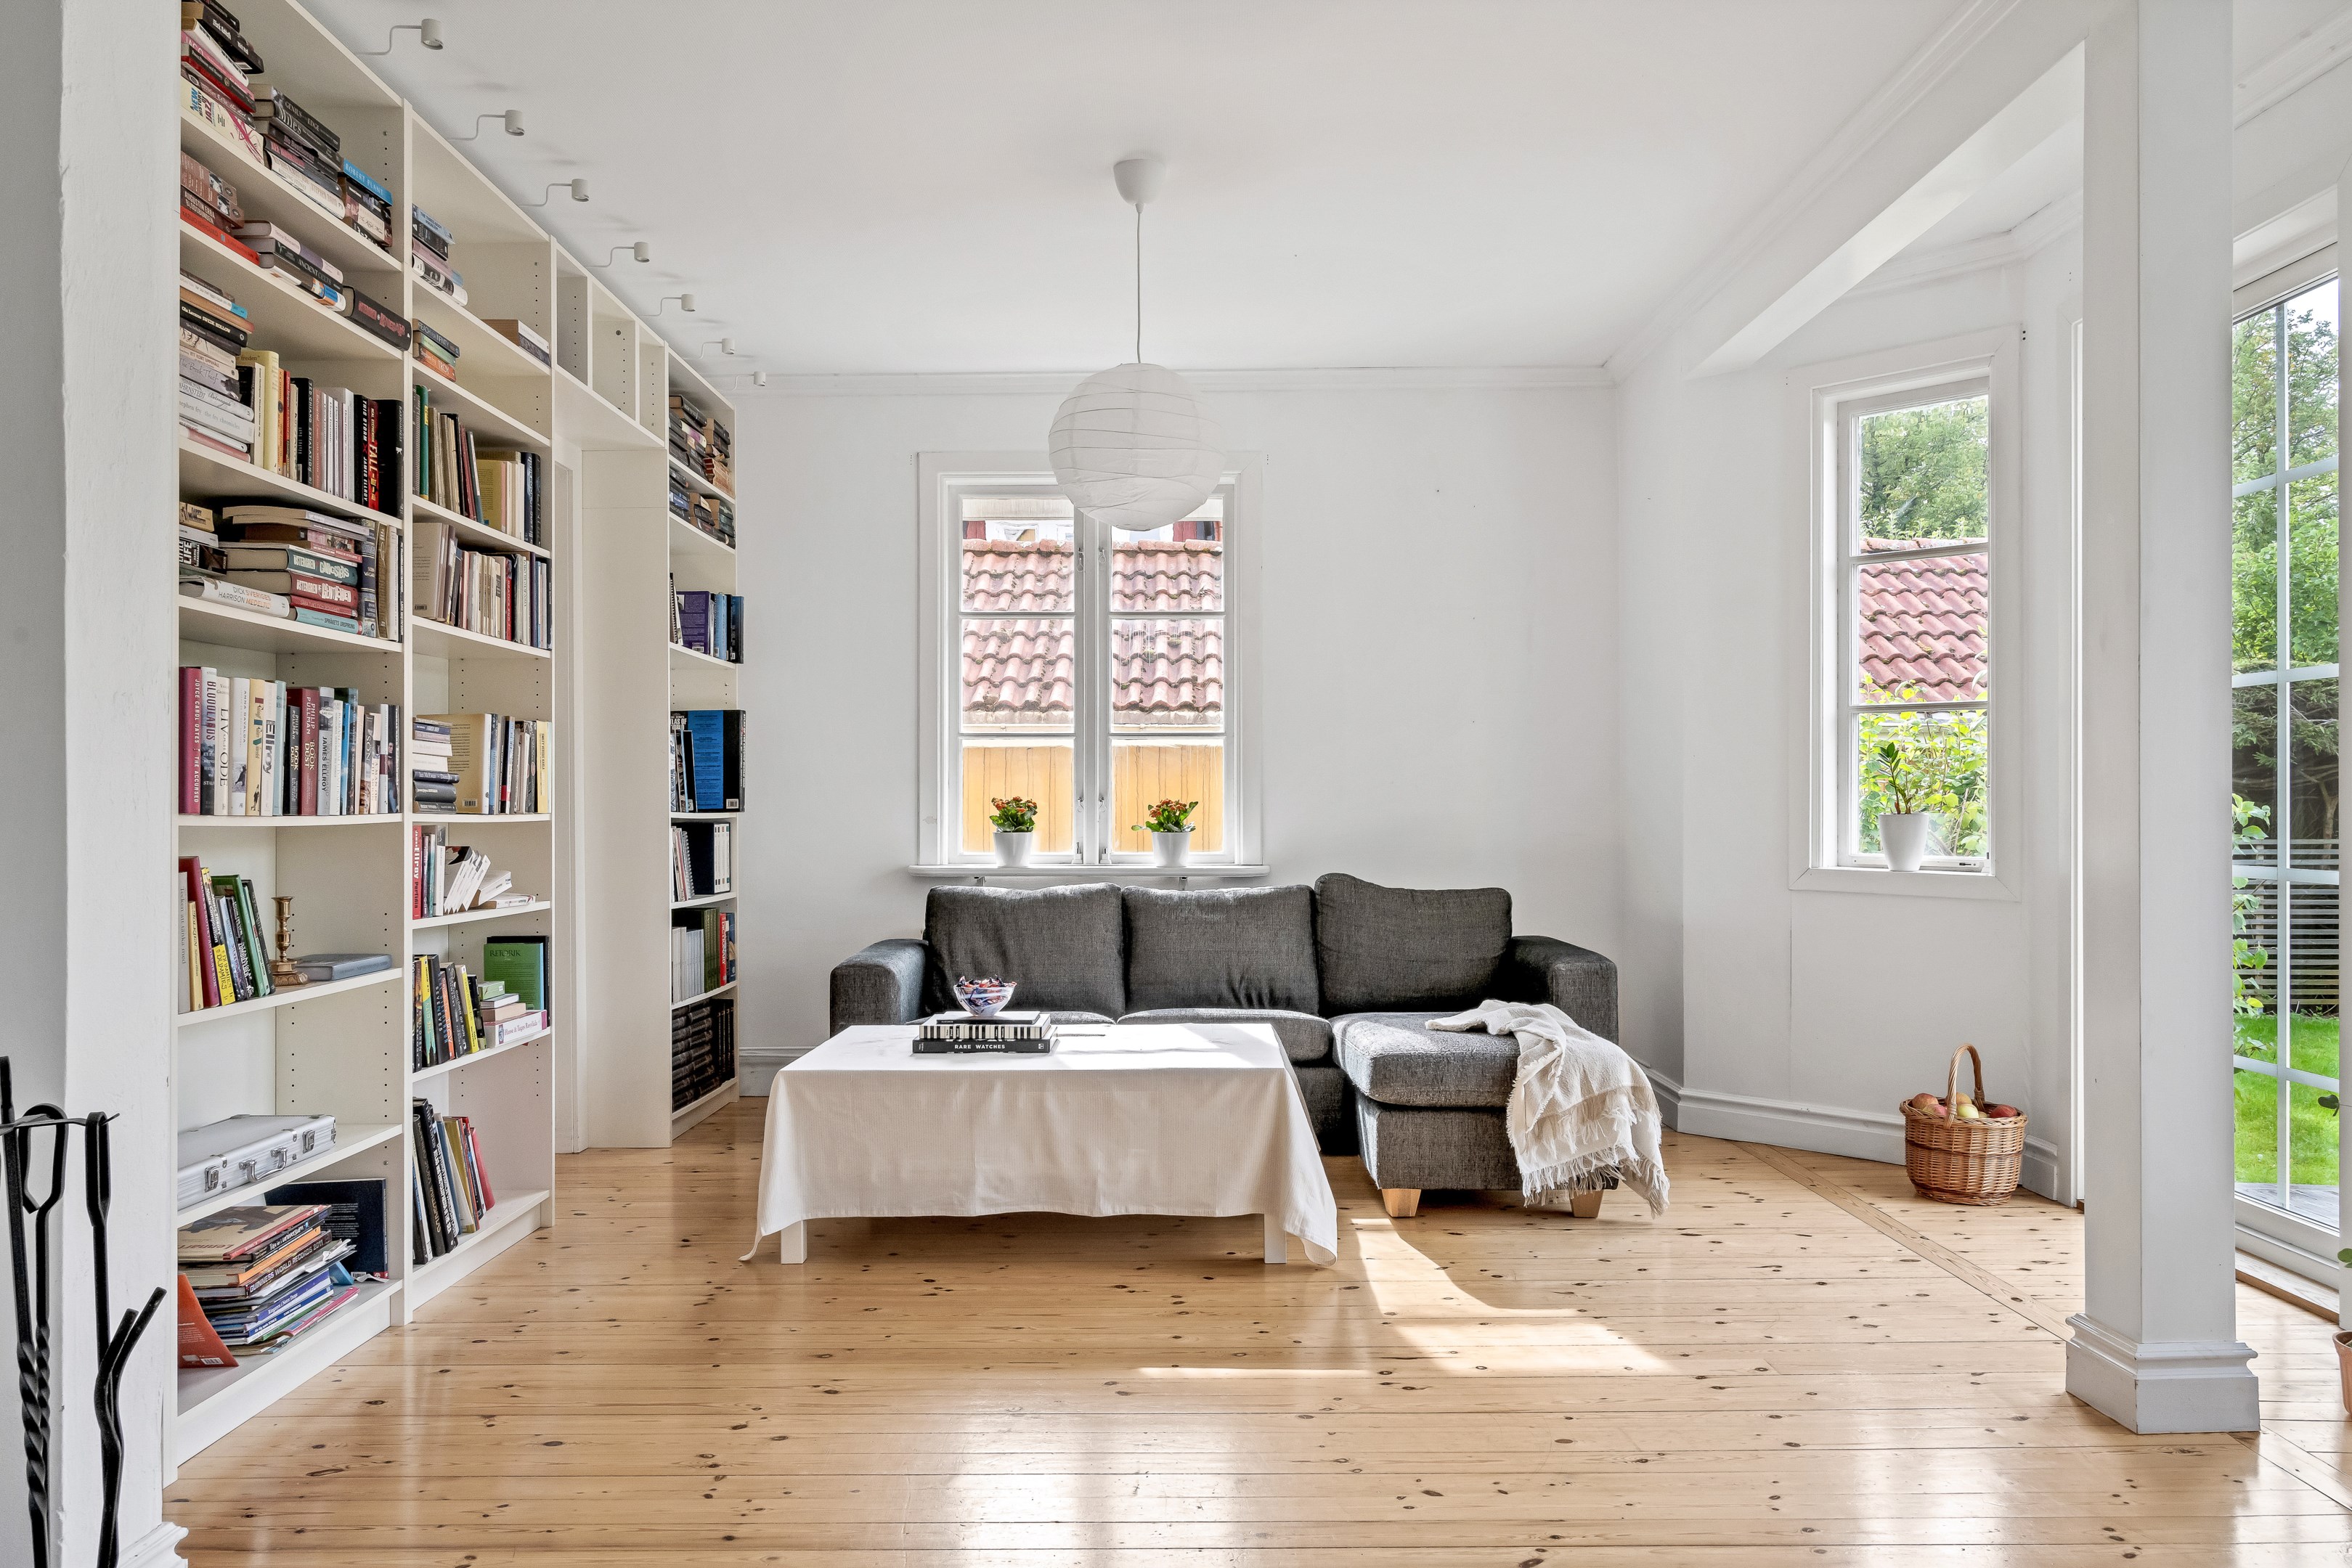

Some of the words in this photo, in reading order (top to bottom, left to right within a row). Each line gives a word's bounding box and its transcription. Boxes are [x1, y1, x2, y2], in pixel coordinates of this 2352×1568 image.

[278, 105, 301, 135] Miles
[285, 102, 302, 117] GENIUS
[345, 163, 366, 183] ROBERT
[366, 179, 384, 196] PLANT
[184, 191, 204, 211] AUGUSTIN
[297, 257, 318, 277] ANCIENT
[215, 322, 232, 334] HOLLOW
[190, 362, 205, 377] Book
[438, 360, 450, 375] TROY
[369, 444, 378, 473] FALL
[183, 540, 192, 565] LIFE
[218, 591, 245, 604] HARRISON
[233, 586, 245, 596] DICK
[245, 589, 272, 601] SVERIGES
[324, 617, 340, 626] SPRÅKETS
[339, 620, 356, 629] URSPRUNG
[206, 681, 216, 740] BLOODLANDS
[263, 719, 276, 775] Ellroy
[208, 906, 219, 943] Composition
[216, 954, 227, 990] DUMMIES
[221, 955, 232, 988] DUMMIES
[249, 1271, 275, 1293] GUINNESS
[274, 1261, 292, 1276] WORLD
[292, 1247, 314, 1265] RECORDS
[313, 1239, 324, 1250] 2011
[282, 1298, 291, 1307] Notre
